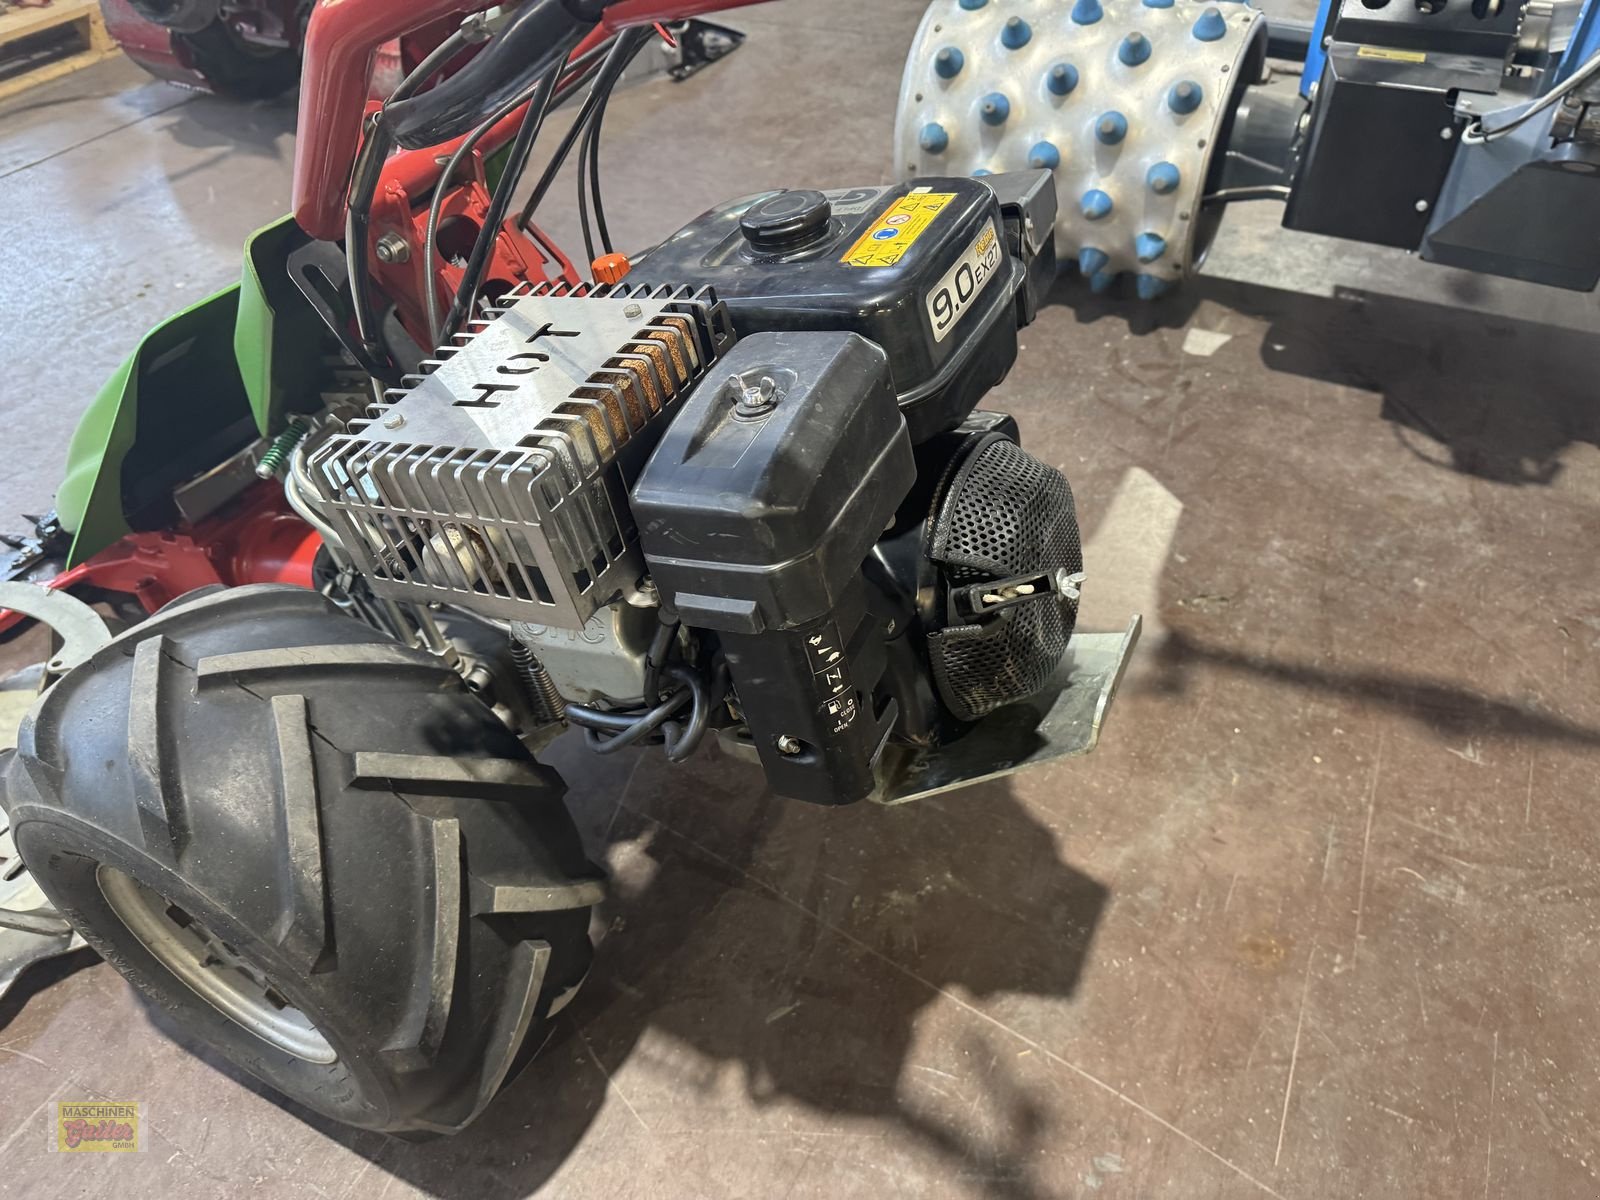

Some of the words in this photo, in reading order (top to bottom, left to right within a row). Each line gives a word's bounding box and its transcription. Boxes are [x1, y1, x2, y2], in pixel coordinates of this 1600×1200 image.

[932, 262, 975, 330] 9.0
[974, 242, 999, 285] EX27
[452, 323, 581, 408] HOT
[833, 722, 849, 733] OPEN
[840, 704, 855, 717] CLOSE
